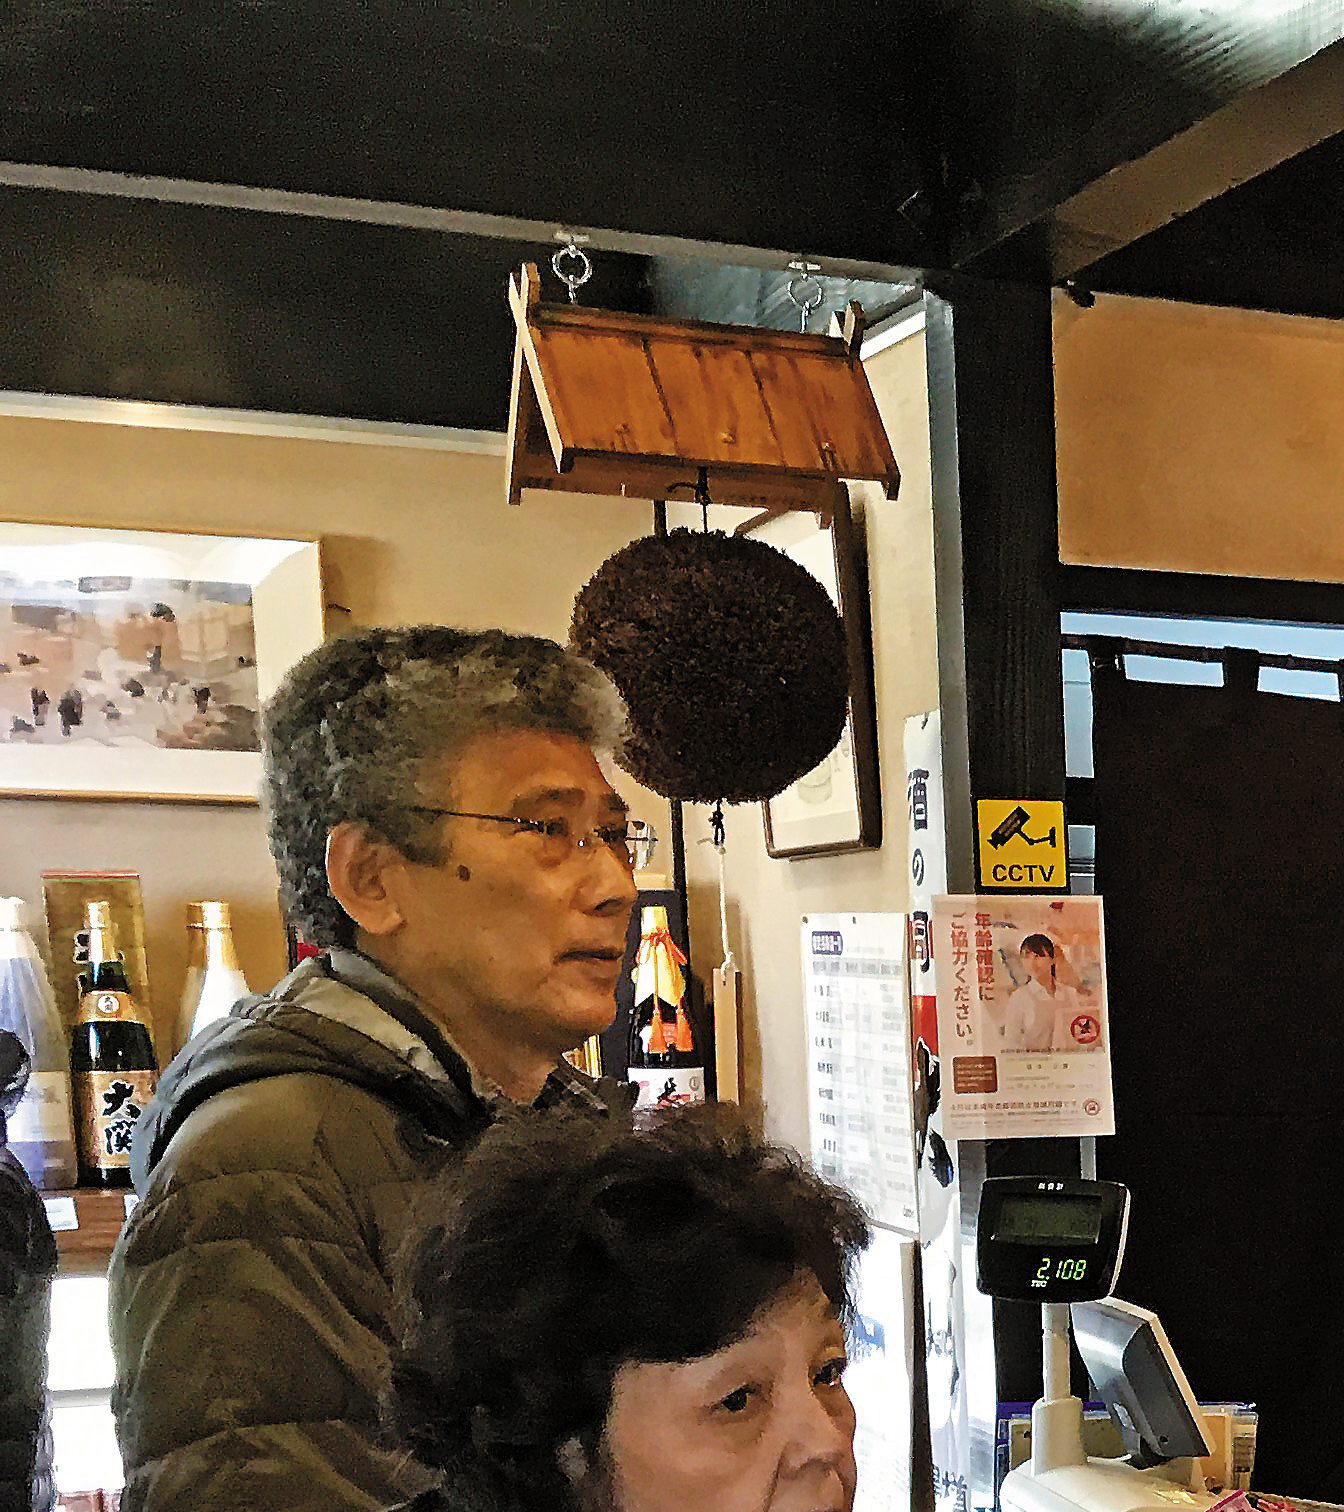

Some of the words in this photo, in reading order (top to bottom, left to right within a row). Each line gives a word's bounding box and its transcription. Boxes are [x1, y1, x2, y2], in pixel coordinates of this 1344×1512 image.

[992, 864, 1055, 885] CCTV
[951, 911, 974, 1047] ご協力ください。
[975, 911, 995, 1001] 年齢確認に
